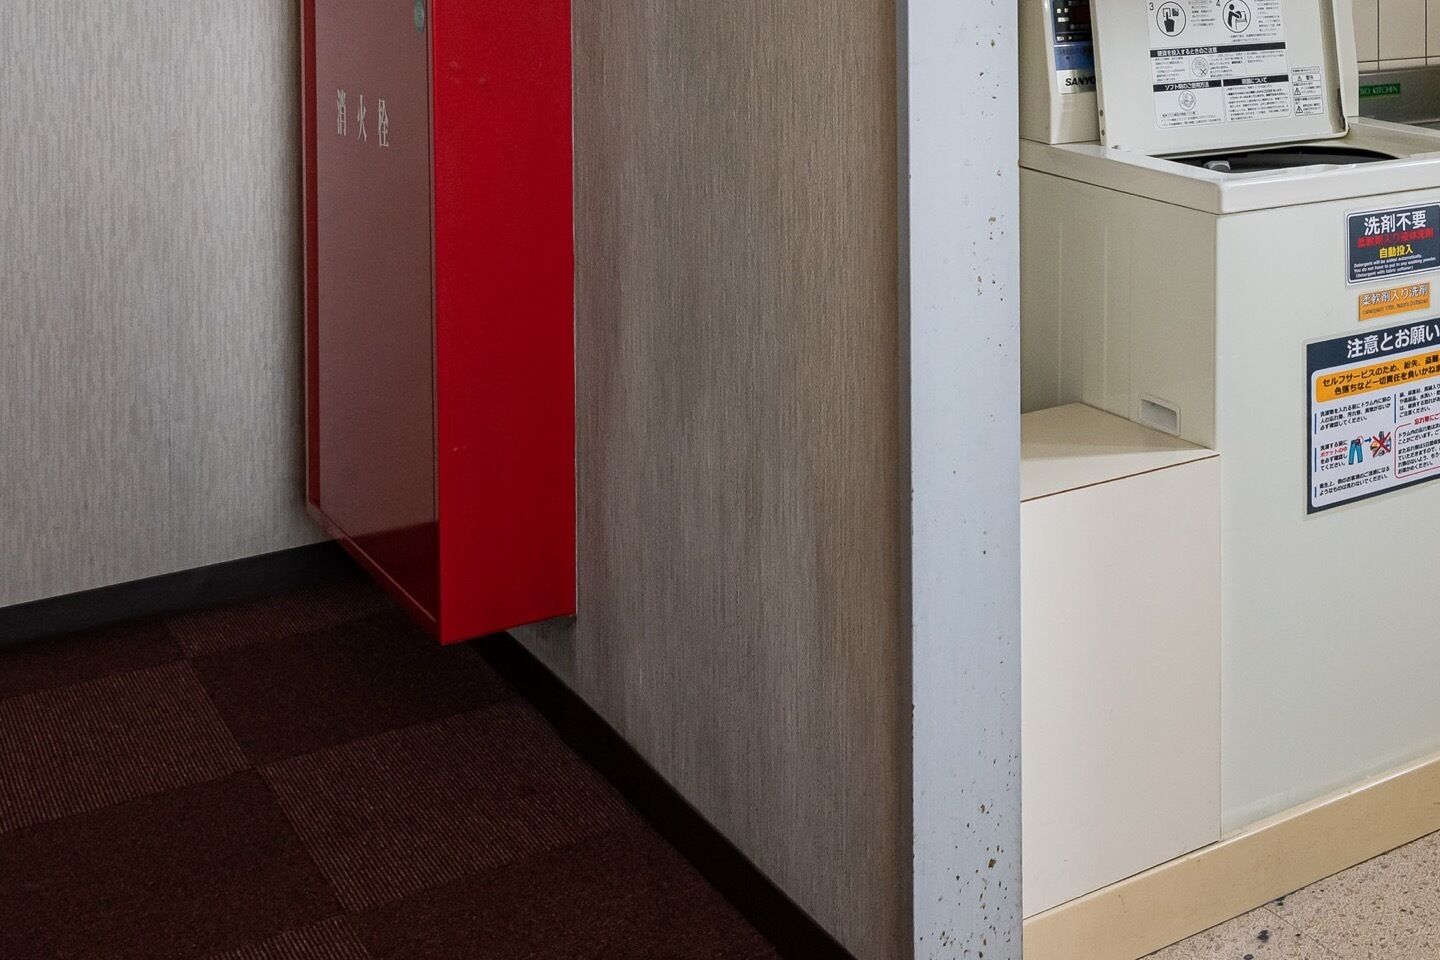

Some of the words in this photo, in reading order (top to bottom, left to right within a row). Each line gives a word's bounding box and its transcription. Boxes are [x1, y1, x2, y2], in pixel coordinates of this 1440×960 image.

[336, 88, 389, 147] 消火栓
[1364, 210, 1427, 235] 洗剤不要
[1379, 244, 1413, 259] 自動投入
[1346, 324, 1440, 359] 注意とお願い
